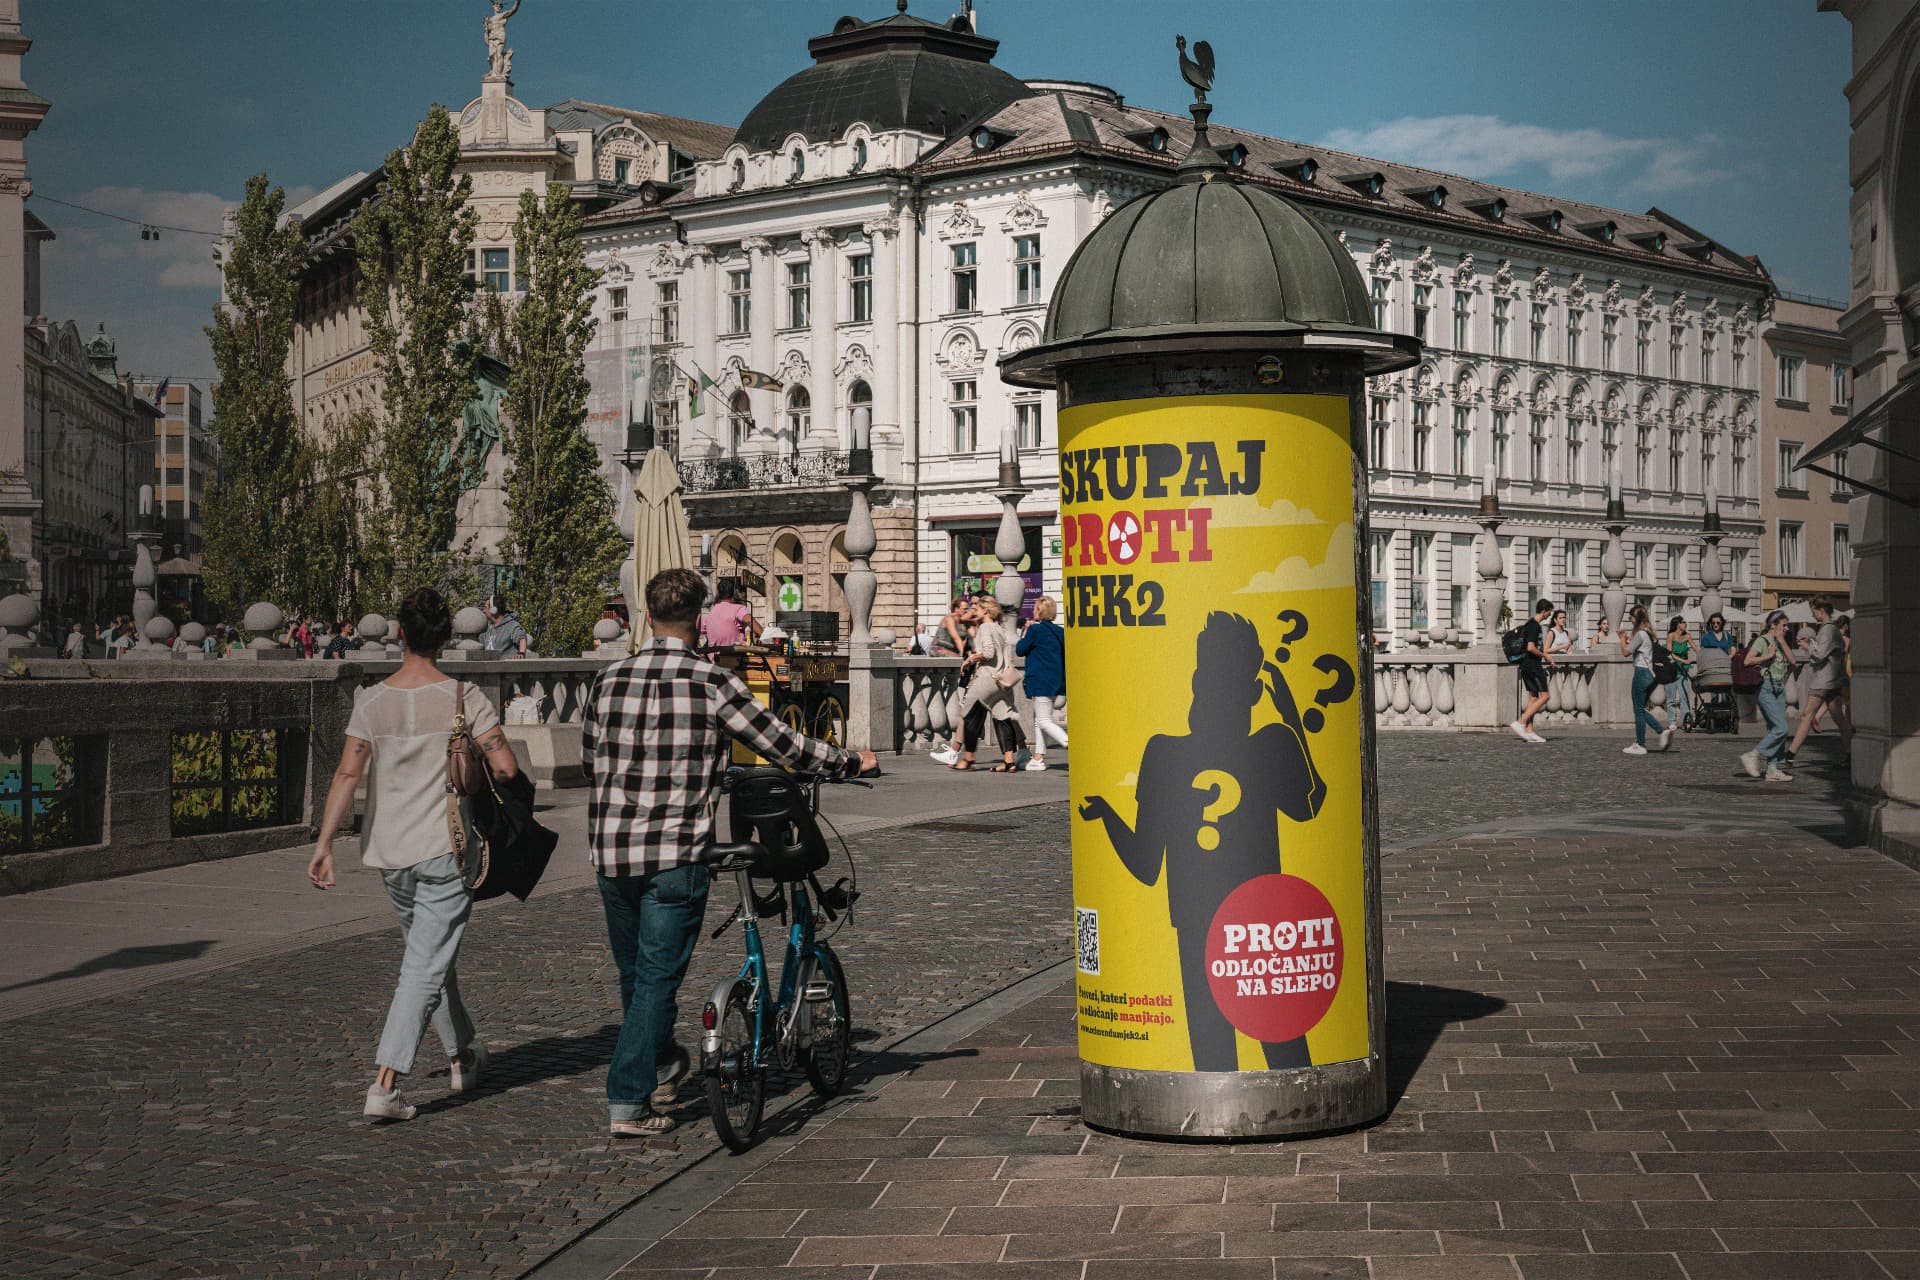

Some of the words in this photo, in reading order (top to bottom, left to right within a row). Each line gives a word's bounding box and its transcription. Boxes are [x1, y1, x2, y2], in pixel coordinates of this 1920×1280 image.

[1061, 440, 1266, 505] SKUPAJ
[1063, 508, 1213, 567] PROTI
[1066, 573, 1167, 629] JEK2
[1223, 917, 1335, 953] PROTI
[1211, 952, 1336, 978] ODLOČANJU
[1100, 990, 1127, 1005] kateri
[1128, 994, 1173, 1007] podatki
[1236, 978, 1268, 997] NA
[1270, 972, 1336, 995] SLEPO
[1119, 1010, 1175, 1026] manjkajo.
